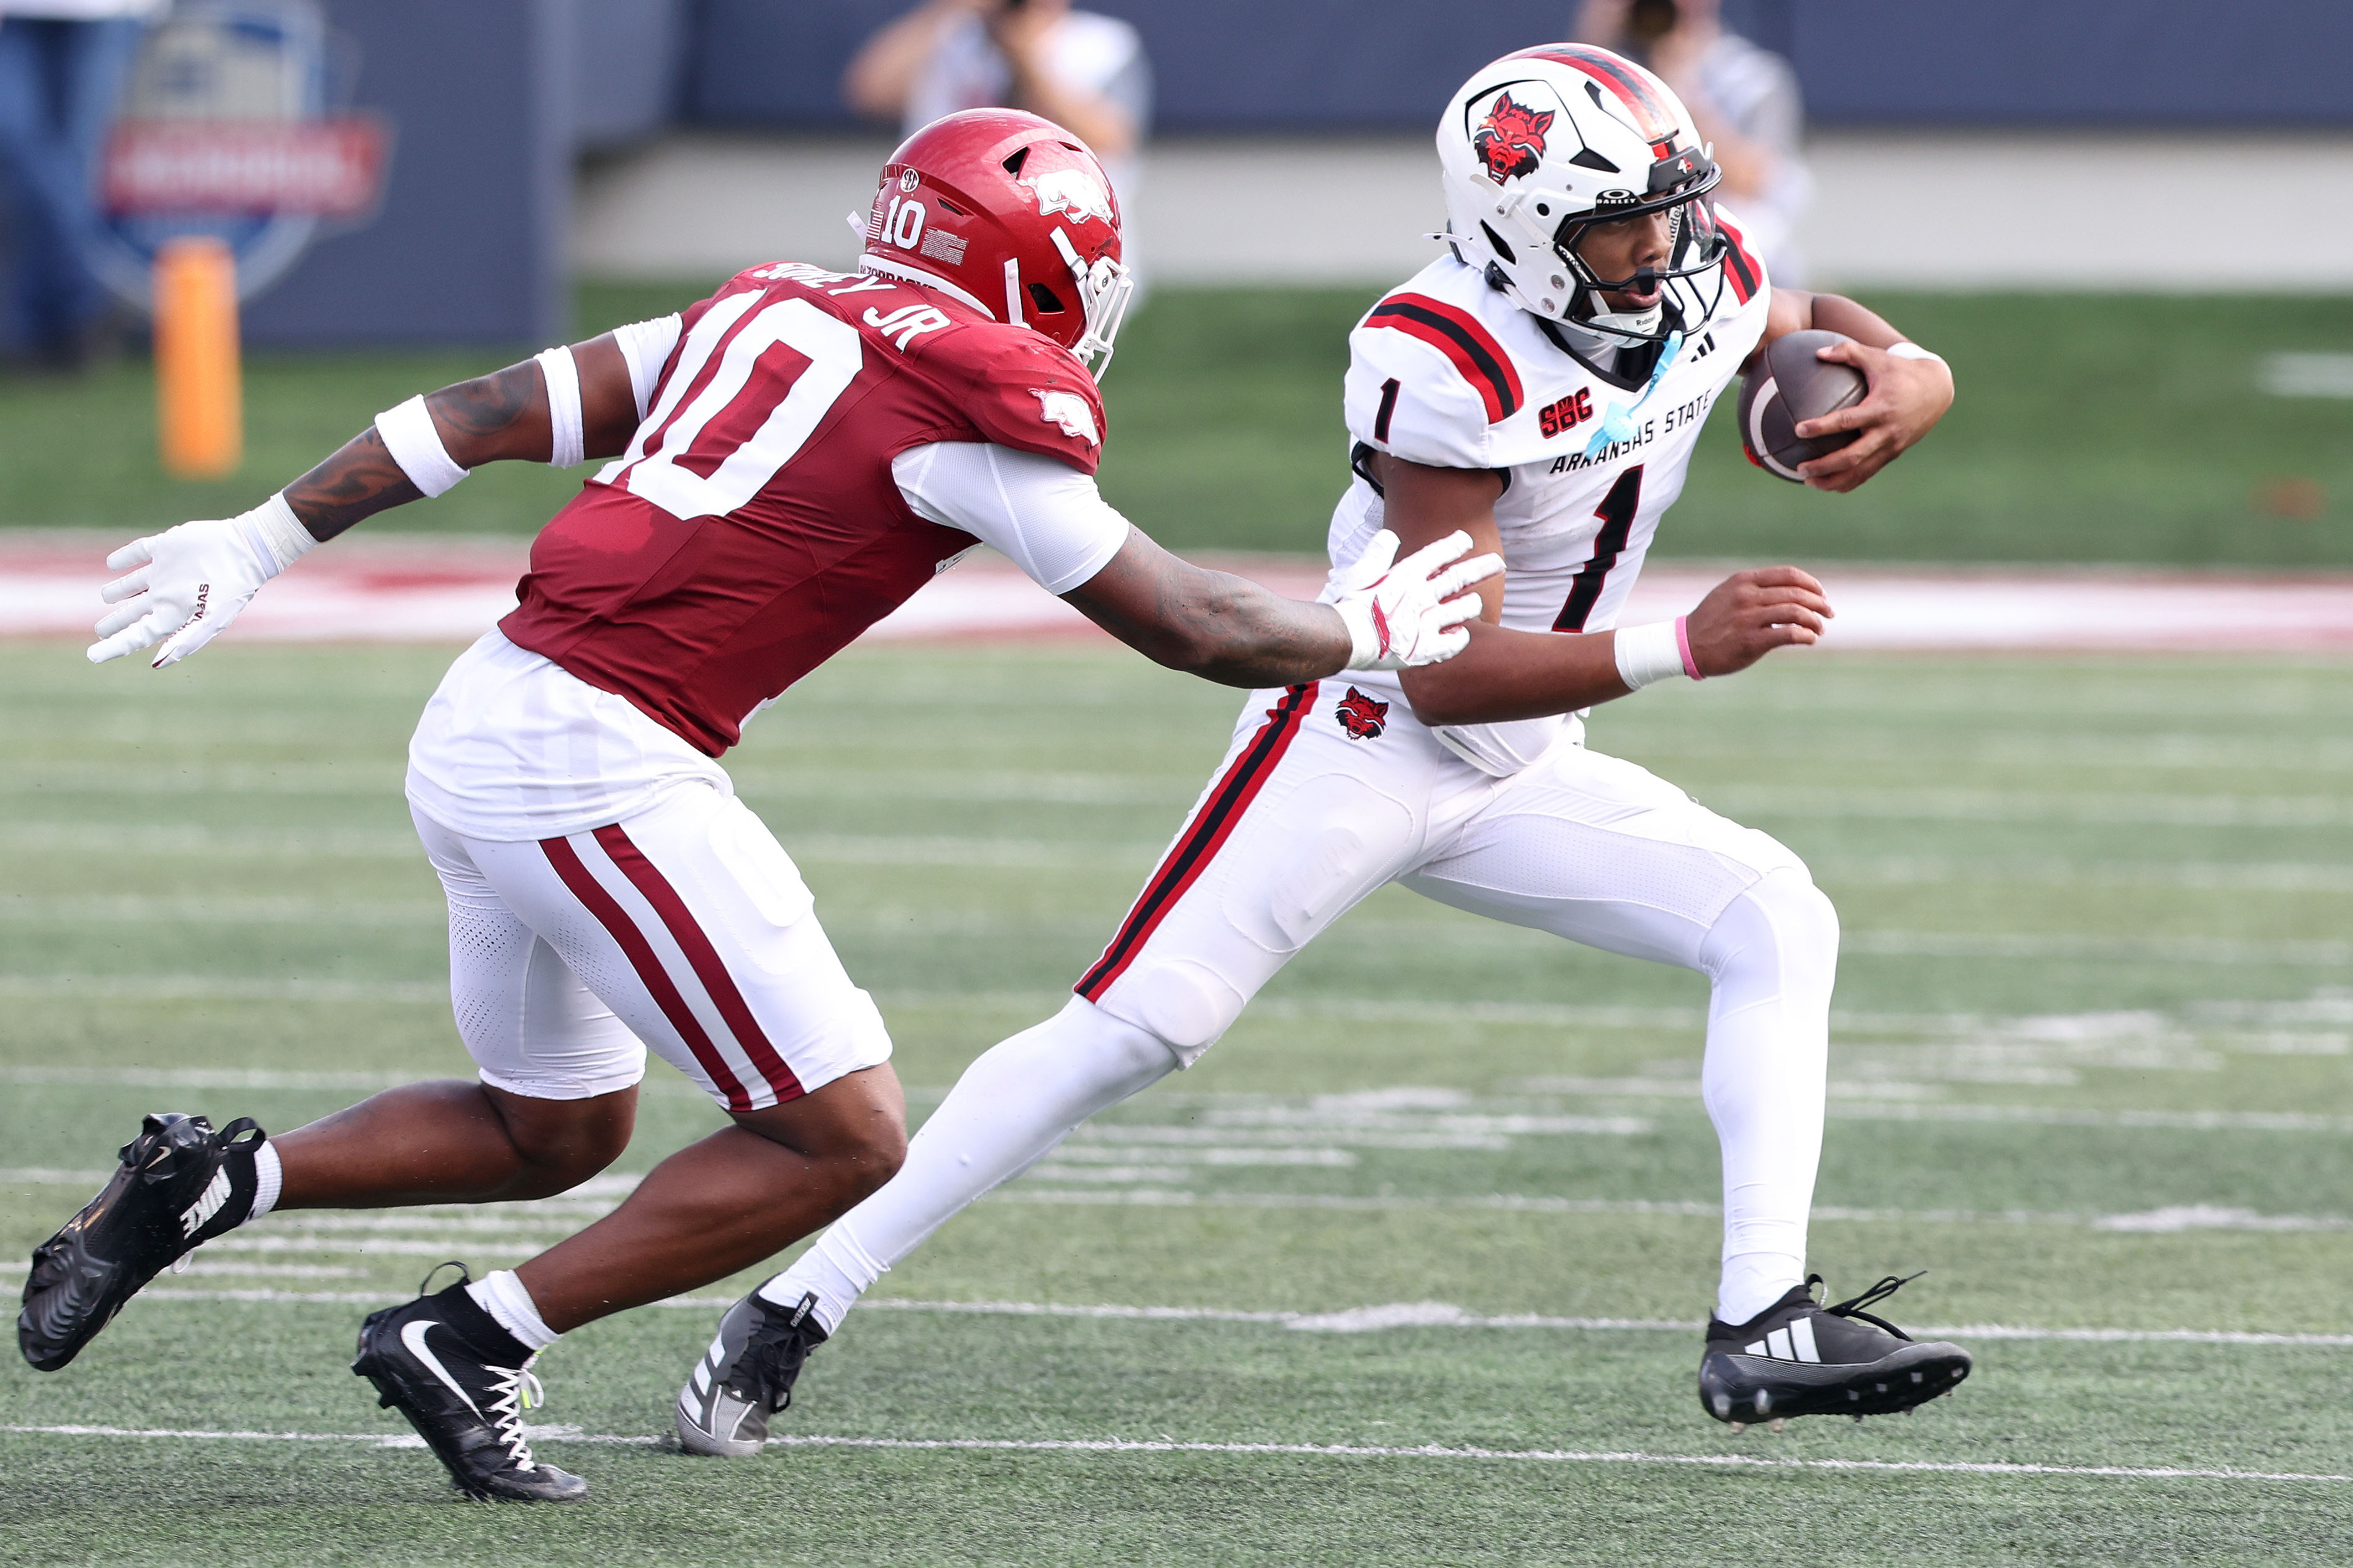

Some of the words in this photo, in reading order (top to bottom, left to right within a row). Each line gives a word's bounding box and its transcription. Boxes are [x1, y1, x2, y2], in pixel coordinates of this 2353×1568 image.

[902, 169, 919, 192] SEC
[881, 195, 927, 250] 10
[862, 304, 952, 354] JR
[591, 288, 864, 521] 10
[1374, 377, 1401, 444] 1
[1538, 386, 1594, 440] SBC
[1664, 388, 1712, 434] STATE
[1551, 463, 1645, 633] 1
[179, 1164, 233, 1241] NIKE
